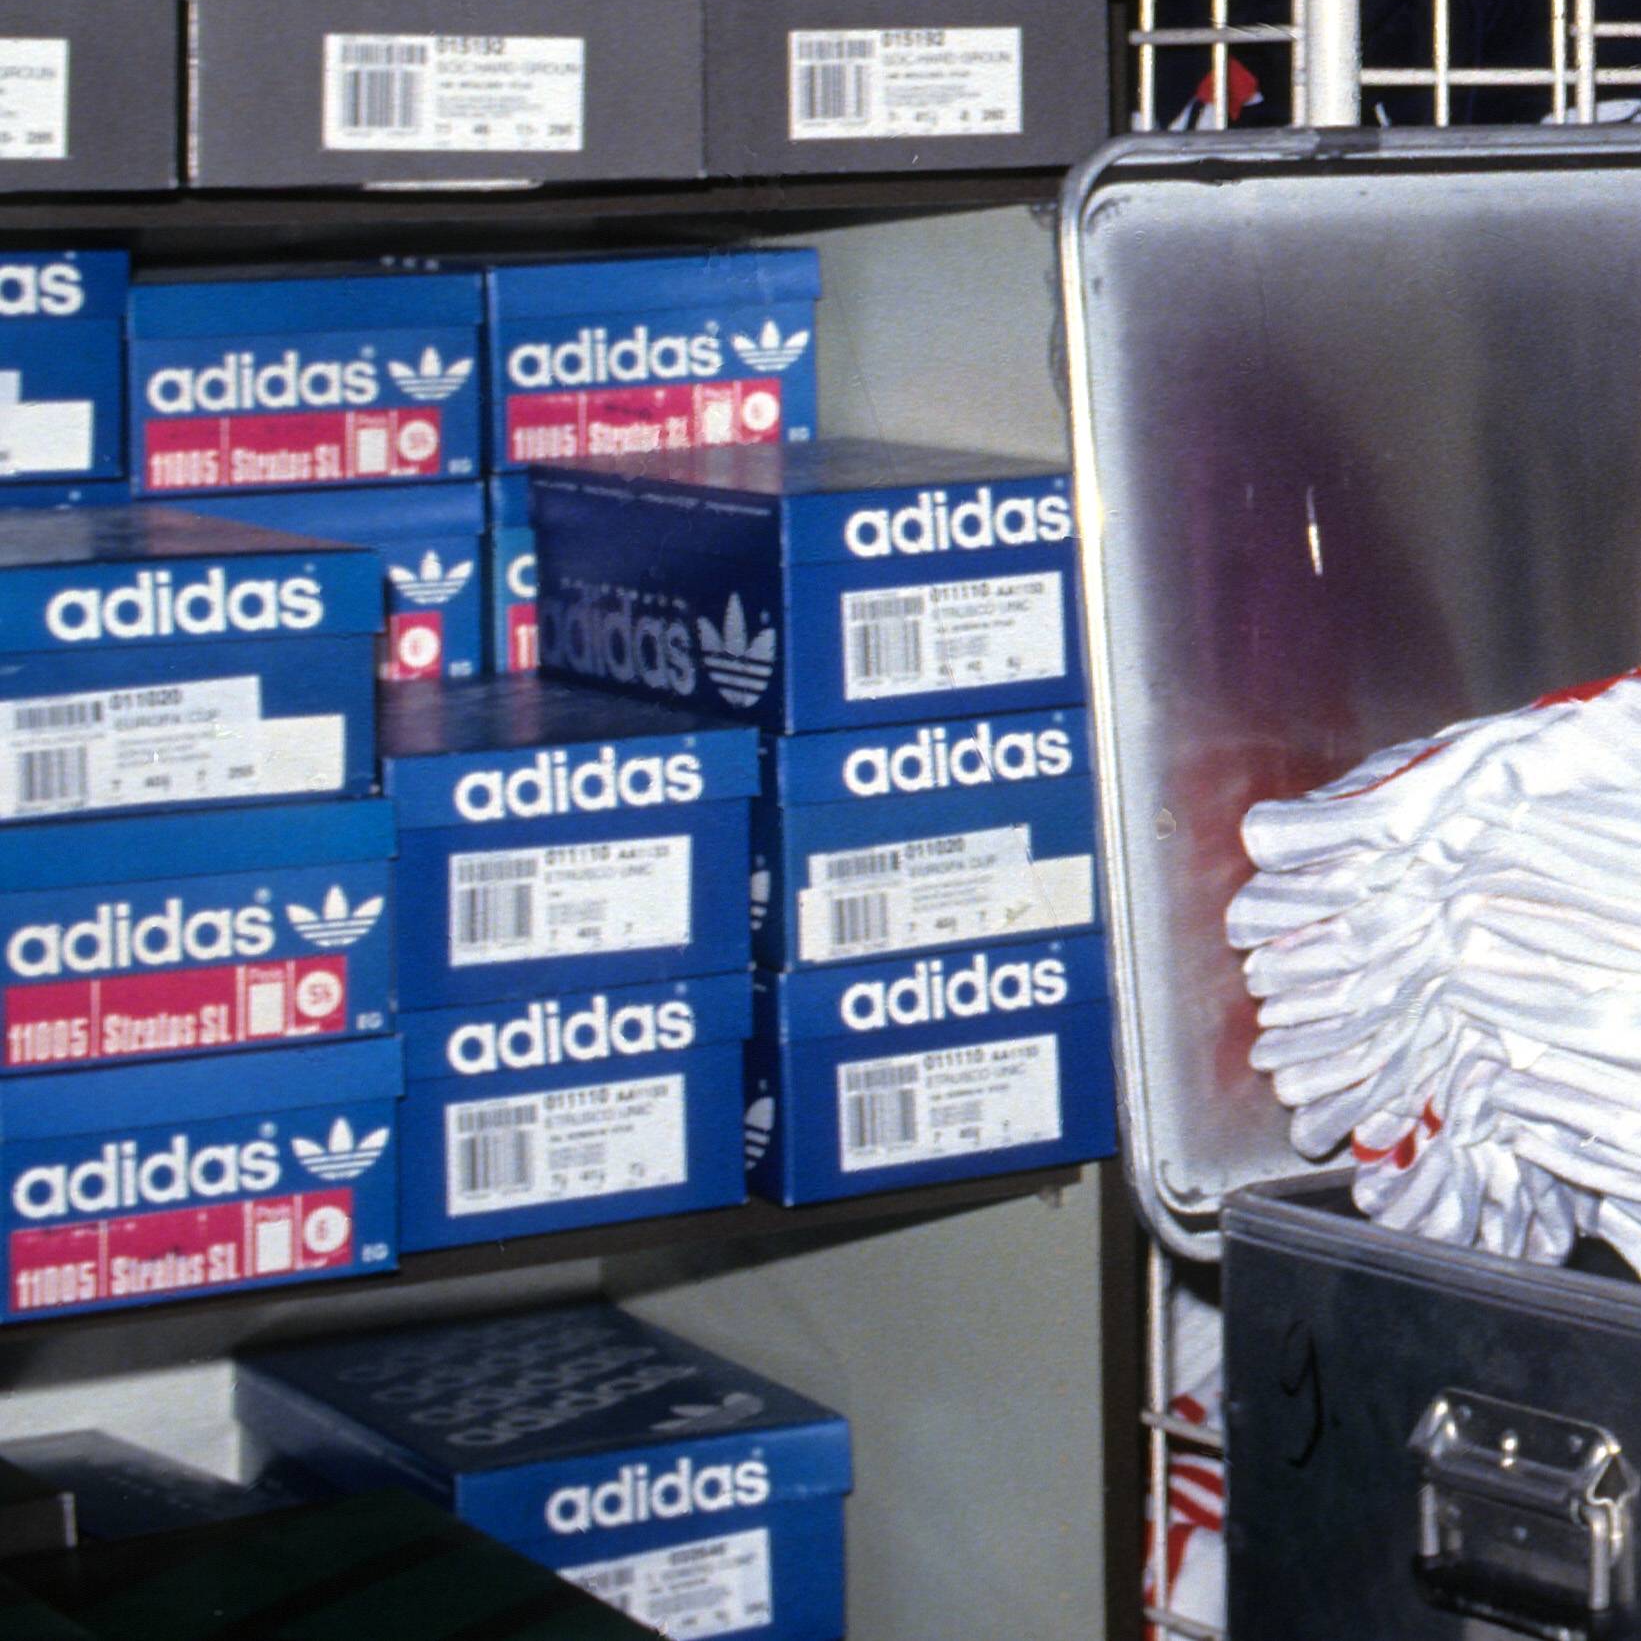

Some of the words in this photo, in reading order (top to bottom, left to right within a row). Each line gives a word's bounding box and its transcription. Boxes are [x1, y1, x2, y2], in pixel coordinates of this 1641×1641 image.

[147, 349, 380, 414] adidas
[508, 326, 724, 389] adidas
[845, 485, 1072, 559] adidas
[46, 566, 325, 642] adidas
[454, 747, 703, 823] adidas
[843, 724, 1073, 796] adidas
[7, 898, 275, 978] adidas
[841, 956, 1069, 1031] adidas
[447, 996, 697, 1075] adidas
[13, 1135, 282, 1220] adidas
[543, 1453, 770, 1535] adidas
